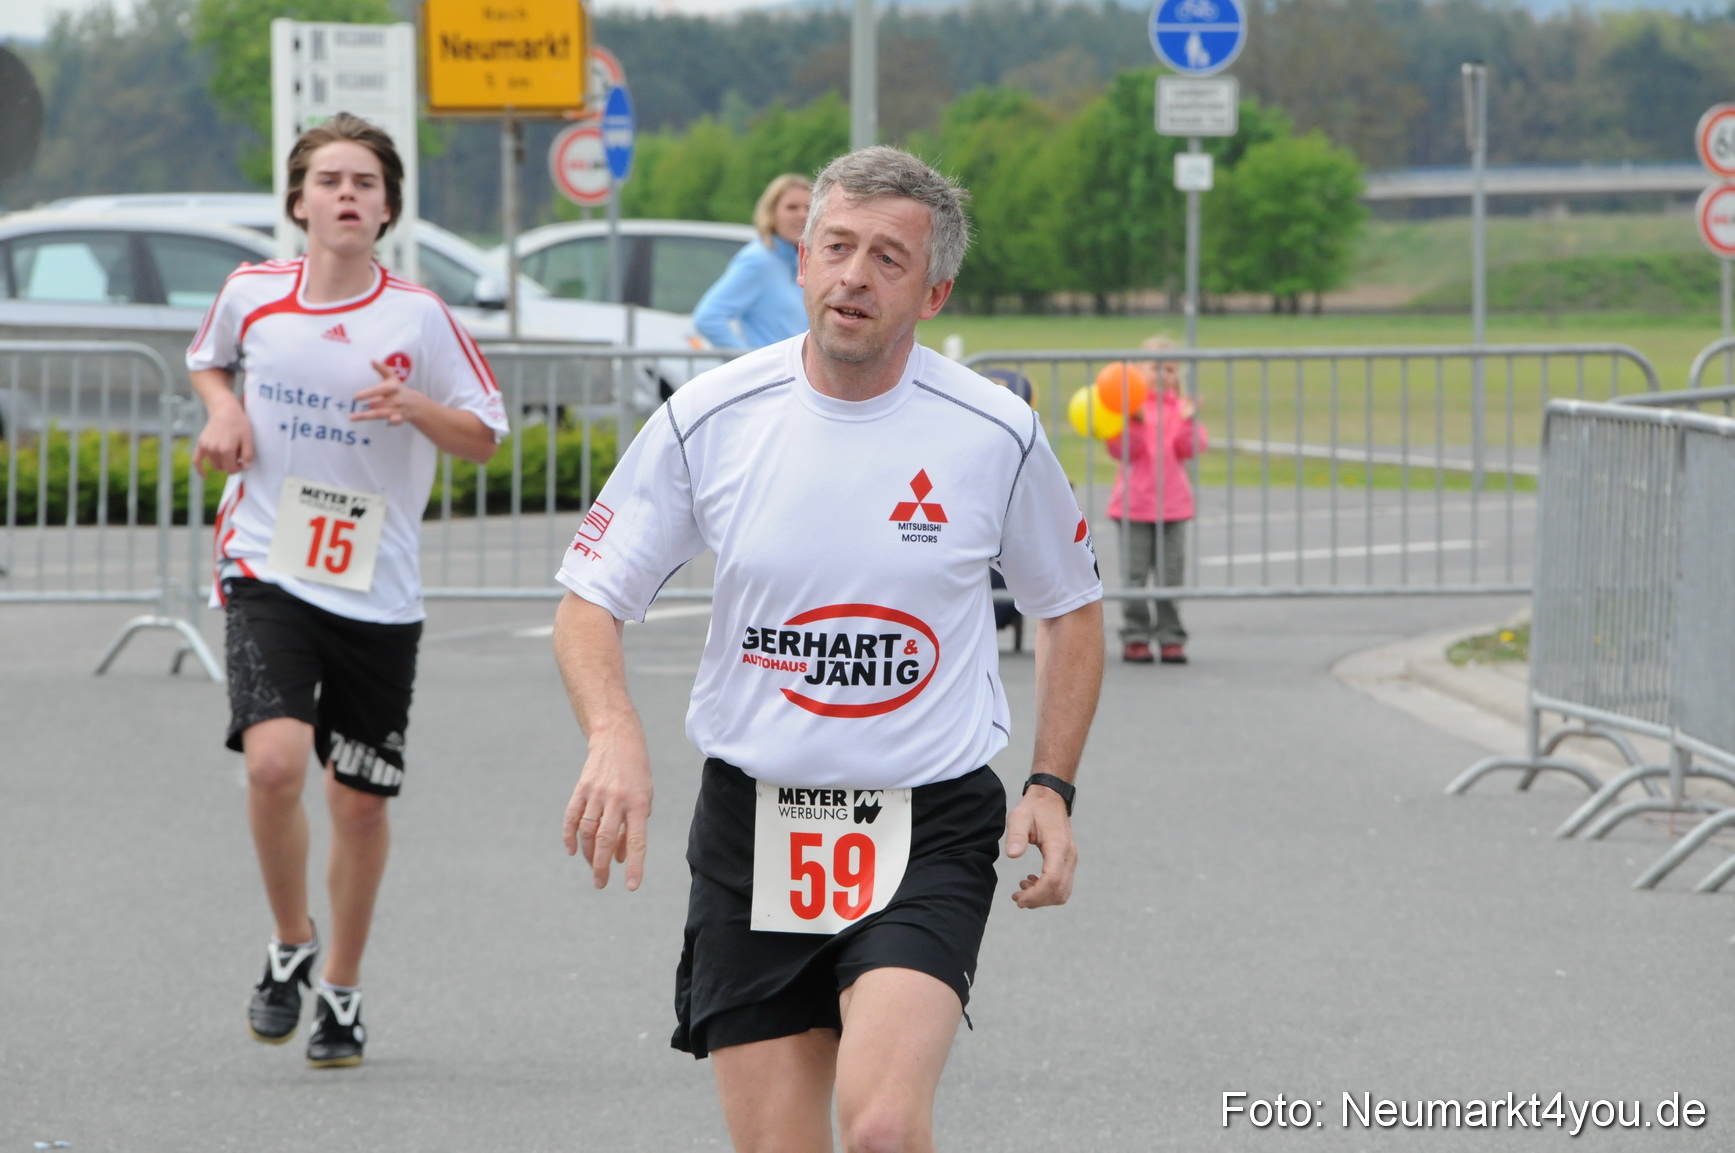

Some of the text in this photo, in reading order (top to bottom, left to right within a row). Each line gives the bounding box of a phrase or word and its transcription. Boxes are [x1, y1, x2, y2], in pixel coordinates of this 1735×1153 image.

[439, 32, 570, 61] Neumarkt
[290, 416, 357, 446] jeans
[301, 485, 348, 505] MEYER
[898, 522, 942, 532] MITSUBISHI
[901, 533, 938, 544] MOTORS
[306, 515, 357, 575] 15
[742, 626, 919, 659] GERHART &
[742, 653, 920, 687] AUTOHAUS JÄNIG
[778, 787, 847, 807] MEYER
[778, 805, 849, 821] WERBUNG
[789, 831, 876, 921] 59
